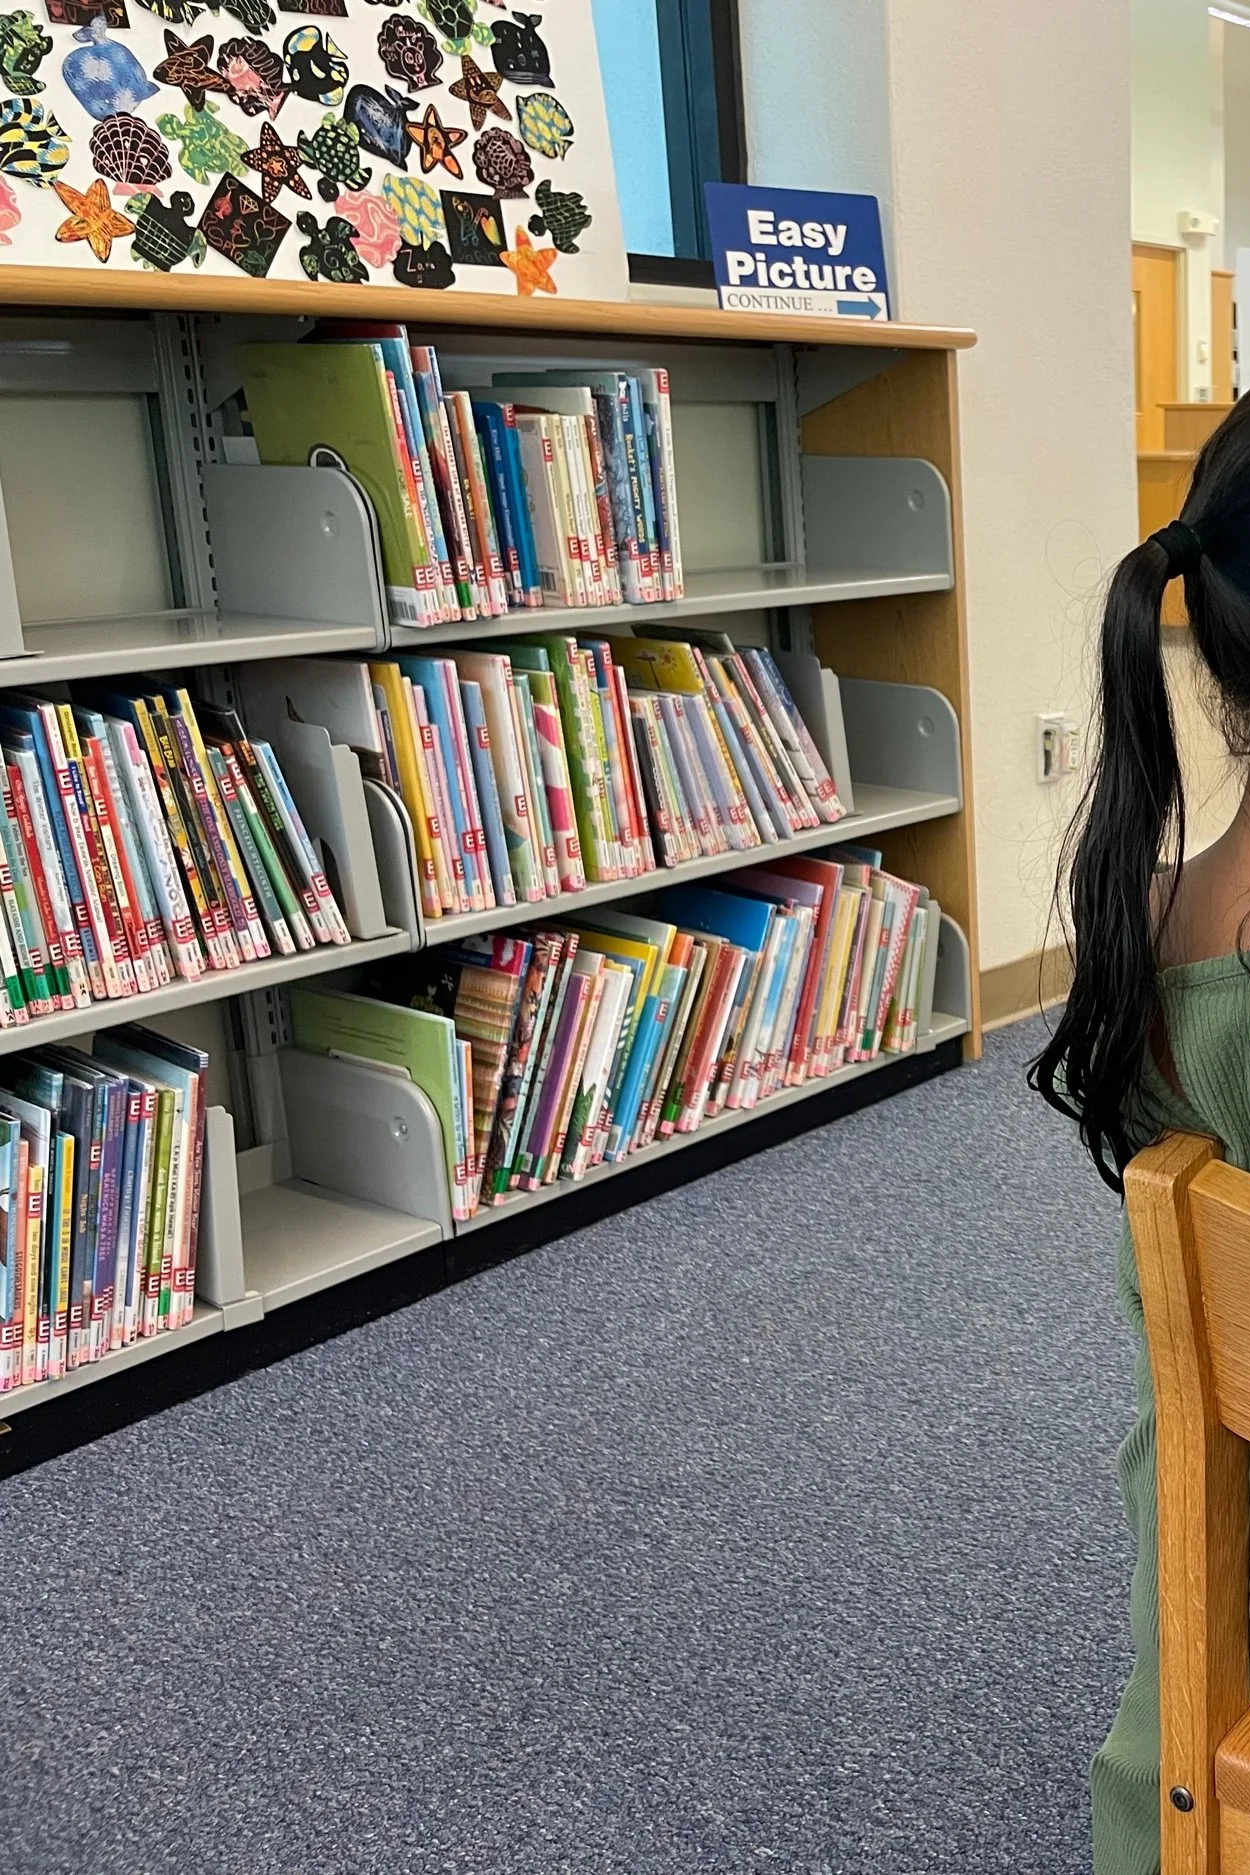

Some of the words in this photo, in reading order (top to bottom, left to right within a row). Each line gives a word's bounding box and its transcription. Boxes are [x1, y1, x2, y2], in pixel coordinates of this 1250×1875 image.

[747, 210, 847, 255] Easy
[726, 251, 877, 291] Picture
[727, 293, 814, 312] CONTINUE
[624, 433, 637, 472] Rocket's
[630, 475, 641, 510] MIGHTY
[401, 493, 412, 519] SALE
[635, 513, 645, 543] WORDS
[570, 540, 579, 553] E
[582, 542, 589, 555] E
[631, 541, 638, 554] E
[490, 557, 502, 571] E
[642, 558, 650, 571] E
[664, 553, 672, 566] E
[415, 567, 425, 584] E
[442, 563, 452, 578] E
[458, 560, 468, 576] E
[476, 565, 485, 580] E
[592, 563, 600, 576] E
[587, 658, 595, 672] E
[31, 780, 41, 793] The
[60, 772, 71, 789] E
[194, 779, 205, 794] E
[222, 780, 233, 795] E
[35, 796, 47, 821] Winter
[199, 798, 210, 815] THE
[518, 798, 526, 811] E
[204, 815, 217, 833] ONE
[432, 819, 440, 832] E
[1, 825, 11, 843] Fables
[11, 823, 20, 840] Fables
[16, 842, 24, 856] from
[41, 824, 53, 851] Visitors
[466, 835, 474, 847] E
[478, 832, 485, 845] E
[210, 834, 223, 851] AND
[233, 807, 255, 850] PRINCESS
[250, 852, 273, 898] HYACINTH
[9, 858, 17, 867] the
[216, 851, 230, 873] ONLY
[457, 861, 465, 874] E
[10, 867, 21, 883] Deep
[109, 853, 121, 880] Drawing
[117, 880, 125, 897] Book
[315, 876, 327, 890] E
[93, 865, 103, 882] Can
[98, 884, 108, 902] Run
[8, 898, 20, 928] HAYASHI
[76, 906, 87, 923] E
[246, 900, 256, 914] E
[15, 929, 24, 943] AND
[551, 944, 561, 959] E
[570, 938, 578, 953] E
[18, 943, 29, 967] BISHOP
[131, 1101, 140, 1116] E
[145, 1095, 155, 1111] E
[585, 1128, 594, 1141] E
[456, 1167, 466, 1180] E
[30, 1196, 41, 1213] E
[79, 1193, 88, 1216] Night
[78, 1220, 86, 1233] Job
[29, 1241, 37, 1260] days
[60, 1246, 68, 1263] MOOSE
[13, 1251, 23, 1310] STEGOTHESAURUS
[149, 1277, 159, 1292] E
[176, 1272, 185, 1287] E
[26, 1294, 35, 1314] nights
[55, 1313, 67, 1331] E
[71, 1306, 82, 1322] E
[2, 1327, 13, 1344] E
